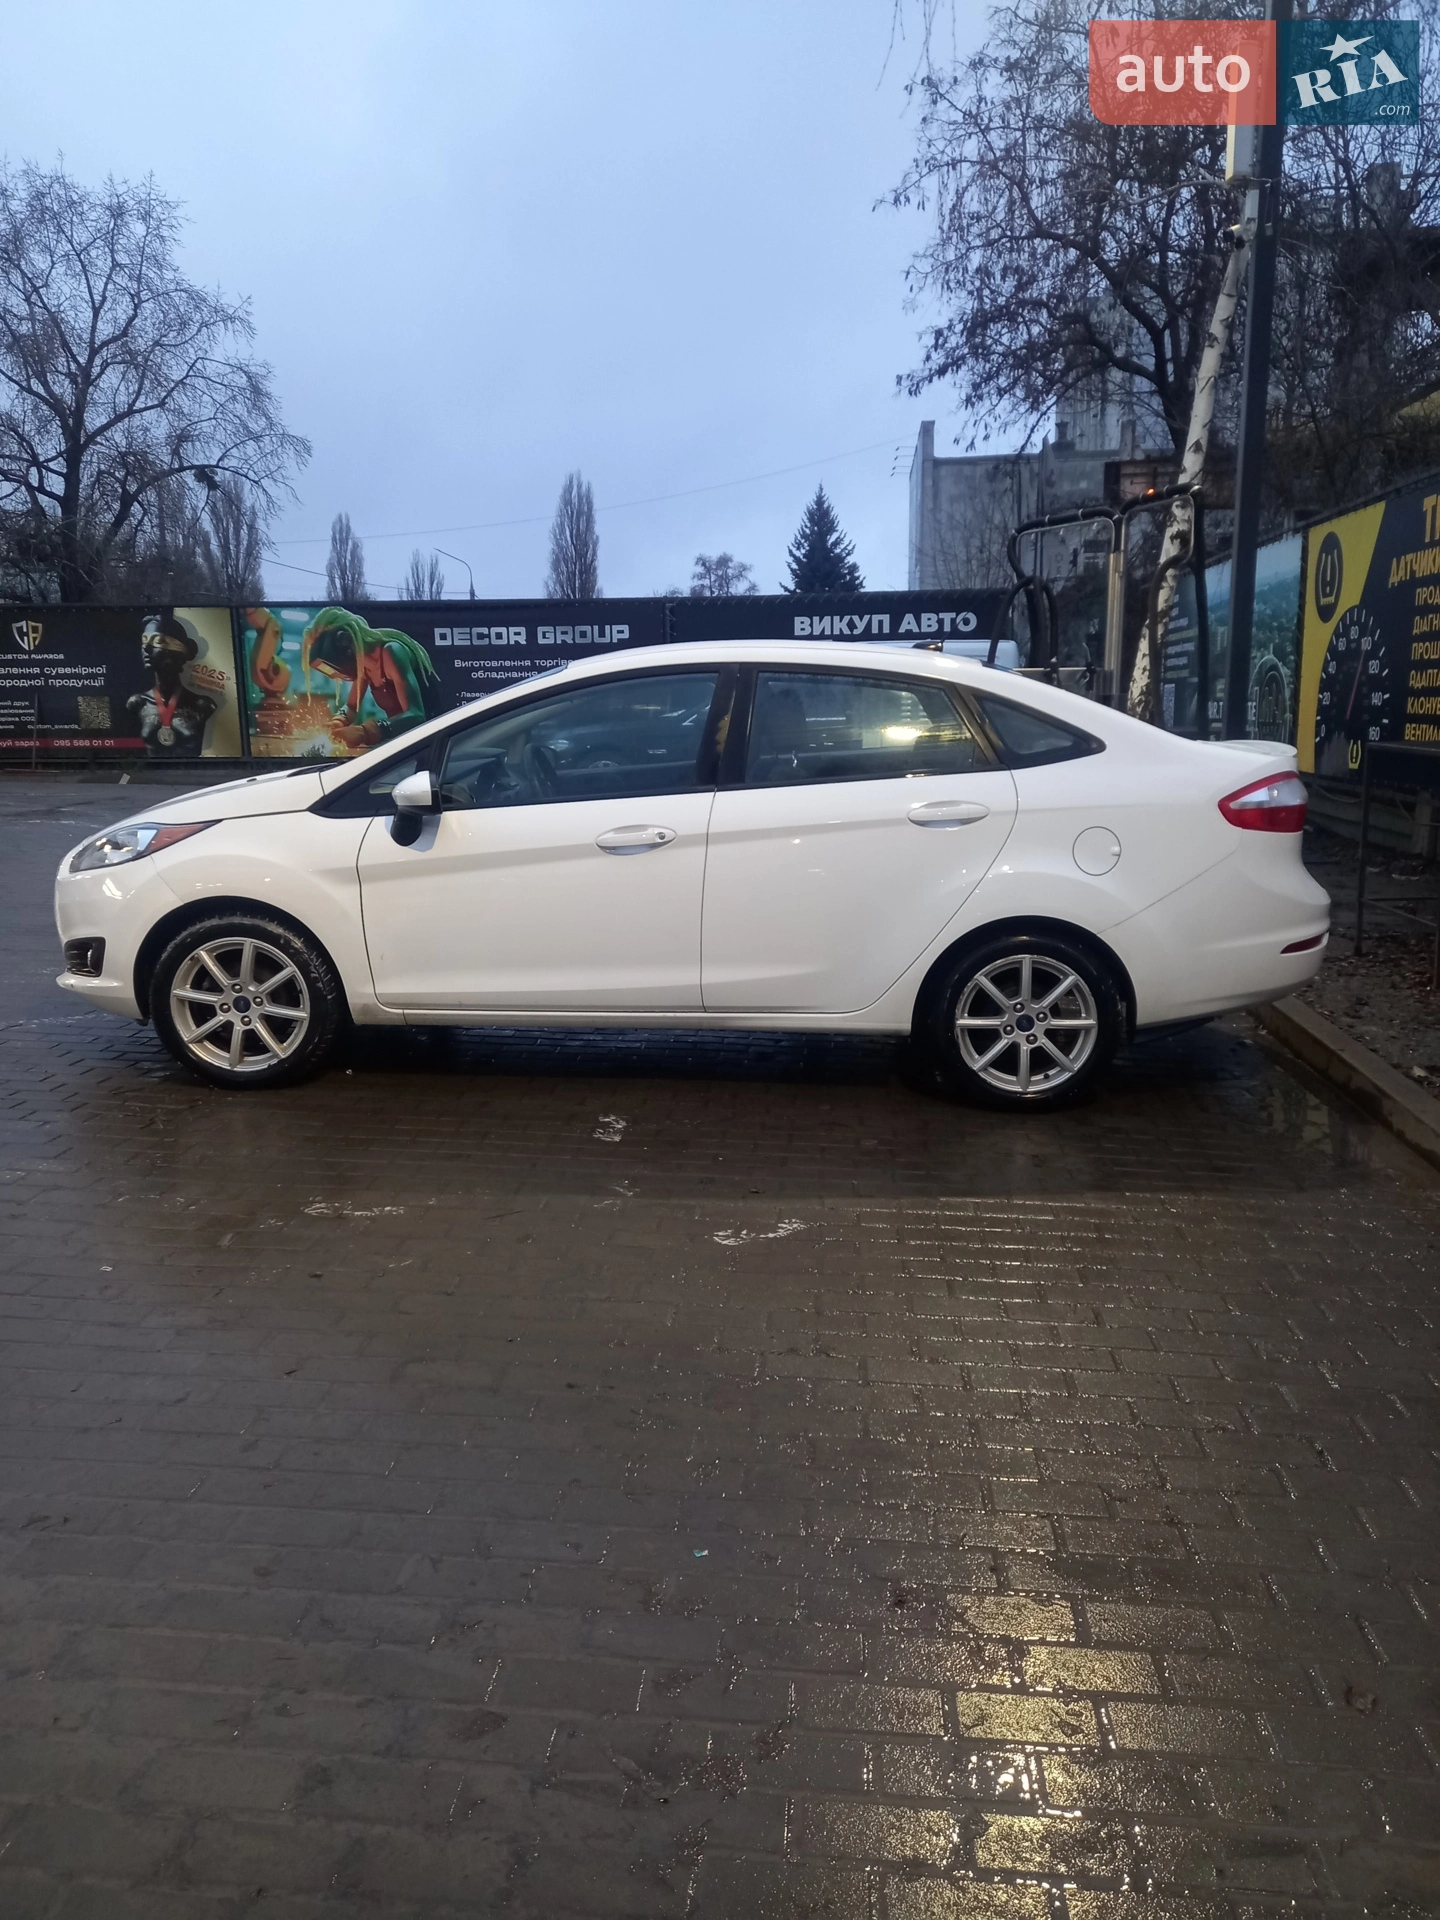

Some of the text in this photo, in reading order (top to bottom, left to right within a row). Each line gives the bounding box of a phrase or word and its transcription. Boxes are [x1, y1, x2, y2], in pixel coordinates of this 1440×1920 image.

[794, 611, 978, 636] ВИКУП АВТО
[434, 624, 630, 646] DECOR GROUP
[44, 665, 107, 676] сувенірної
[454, 659, 531, 668] Виготовлення
[49, 677, 105, 688] продукції
[1404, 723, 1440, 742] ВЕНТИЛ
